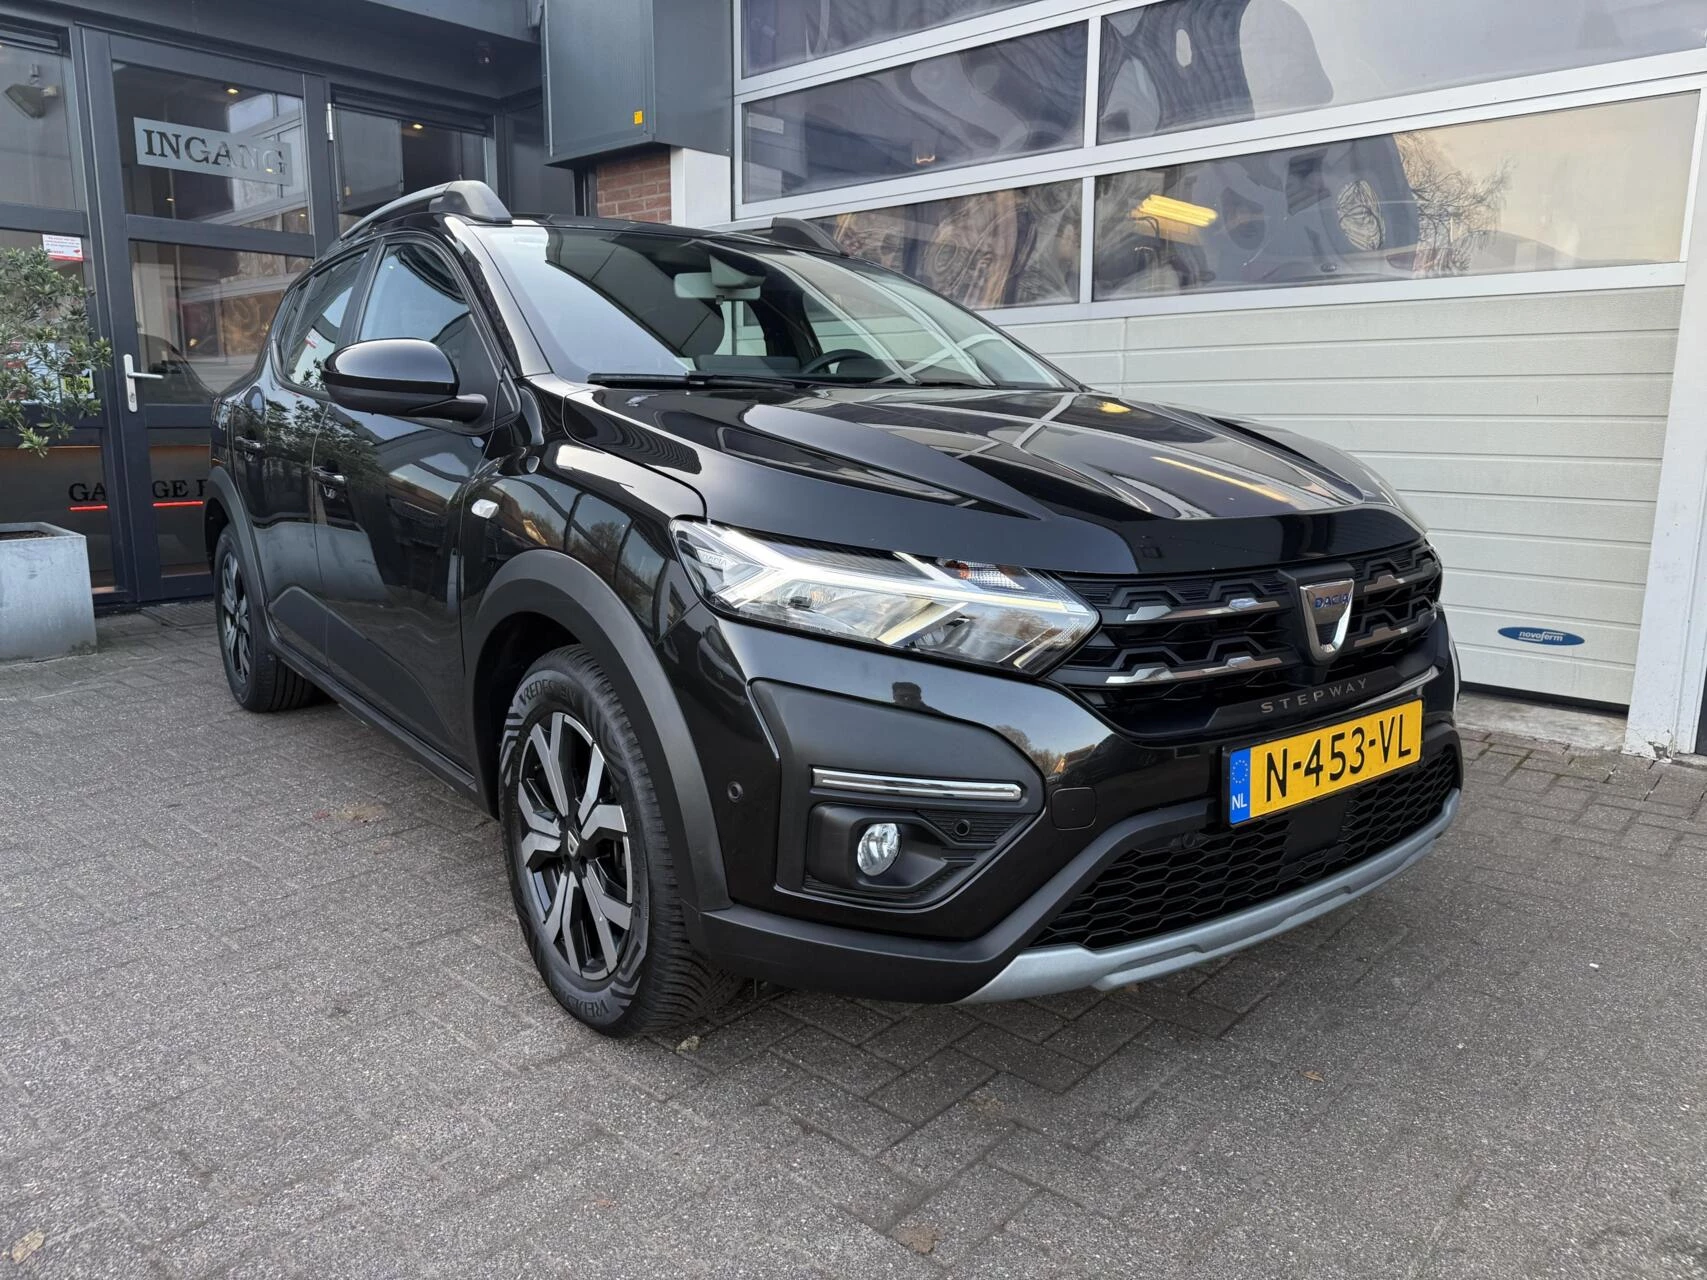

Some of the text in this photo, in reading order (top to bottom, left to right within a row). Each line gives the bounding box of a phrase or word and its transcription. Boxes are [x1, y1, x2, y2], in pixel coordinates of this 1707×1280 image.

[142, 128, 286, 175] INGANG
[68, 479, 188, 502] GAGE
[1315, 593, 1350, 608] DACIA
[1519, 631, 1564, 642] novoferm
[1261, 678, 1367, 713] STEPWAY
[1266, 713, 1411, 802] N-453-VL
[1232, 793, 1247, 810] NL
